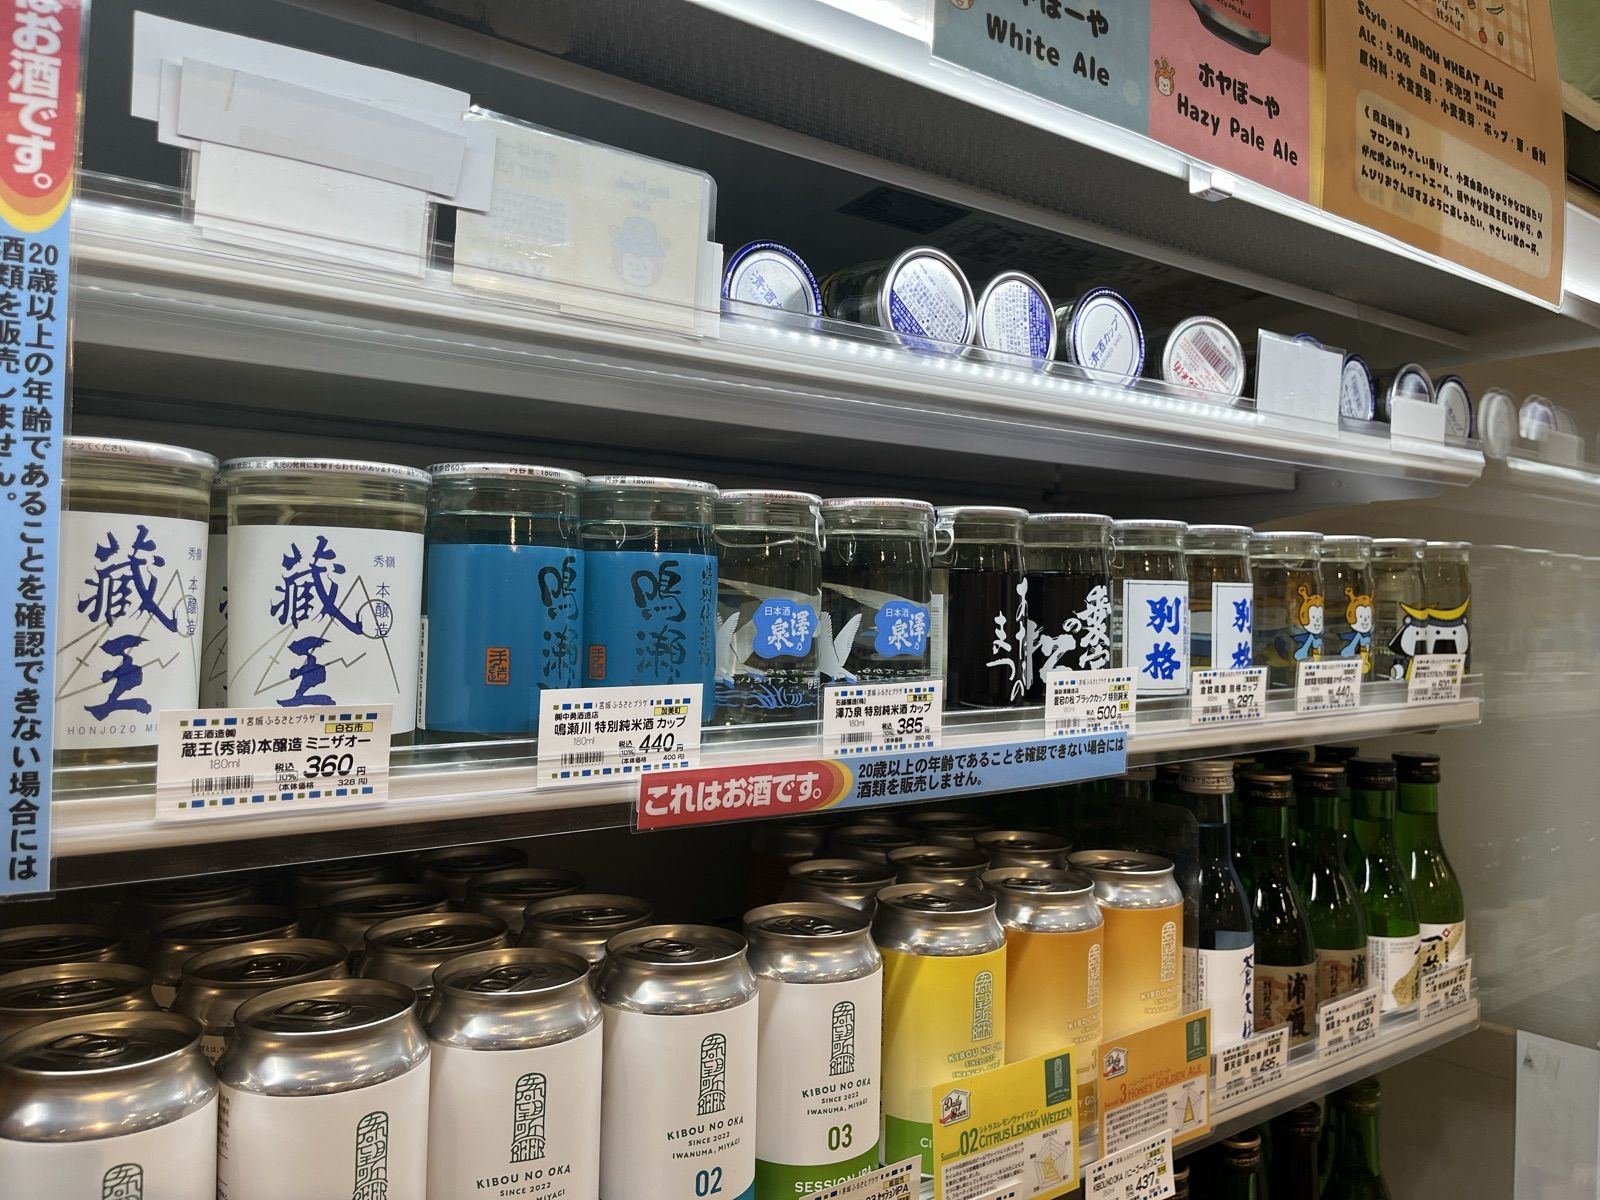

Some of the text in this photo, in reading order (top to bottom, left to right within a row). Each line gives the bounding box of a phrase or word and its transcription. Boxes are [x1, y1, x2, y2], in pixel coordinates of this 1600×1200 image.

[986, 13, 1110, 87] White Ale
[1387, 42, 1411, 68] 5.0%
[1397, 26, 1440, 64] MARRON
[1443, 57, 1480, 87] WHEAT
[1484, 80, 1504, 100] ALE
[1198, 62, 1280, 119] ホヤぼーや
[1177, 93, 1298, 167] Hazy Pale Ale
[9, 242, 58, 881] 20歳以上の年齢であることを確認できない場合には
[764, 606, 791, 617] 日本酒
[885, 607, 909, 617] 日本酒
[1143, 596, 1181, 680] 別格
[864, 704, 908, 717] 特別純米酒
[909, 702, 932, 713] カップ
[1237, 694, 1254, 708] 297
[1097, 705, 1117, 720] 500
[67, 724, 138, 736] HONJOZO
[335, 723, 363, 732] 白石市
[555, 716, 686, 736] 鳴瀬川 特別純米酒 カップ
[896, 717, 923, 735] 385
[306, 735, 371, 750] ミニザオー
[573, 737, 595, 746] 180ml
[619, 733, 683, 753] 税込 440 円
[210, 759, 240, 769] 180ml
[274, 753, 366, 779] 税込 360 円
[858, 737, 1124, 779] 20歳以上の年齢であることを確認できない場合には
[279, 773, 297, 781] 10%
[857, 772, 982, 799] 酒類を販売しません。
[645, 771, 822, 816] これはお酒です。
[948, 1049, 979, 1064] KIBOU
[801, 1077, 871, 1099] KIBOU NO OKA
[821, 1091, 859, 1104] SINCE 2022
[667, 1116, 744, 1140] KIBOU NO OKA
[827, 1123, 853, 1151] 03
[960, 1127, 979, 1156] 02
[979, 1128, 1010, 1148] CITRUS
[1011, 1117, 1041, 1137] LEMON
[1041, 1107, 1072, 1126] WEIZEN
[688, 1132, 730, 1146] SINCE 2022
[672, 1148, 716, 1159] IWANUMA,
[476, 1164, 571, 1190] KIBOU NO OKA
[696, 1166, 722, 1197] 02
[1136, 1171, 1155, 1191] 437
[499, 1182, 551, 1197] SINCE 2022
